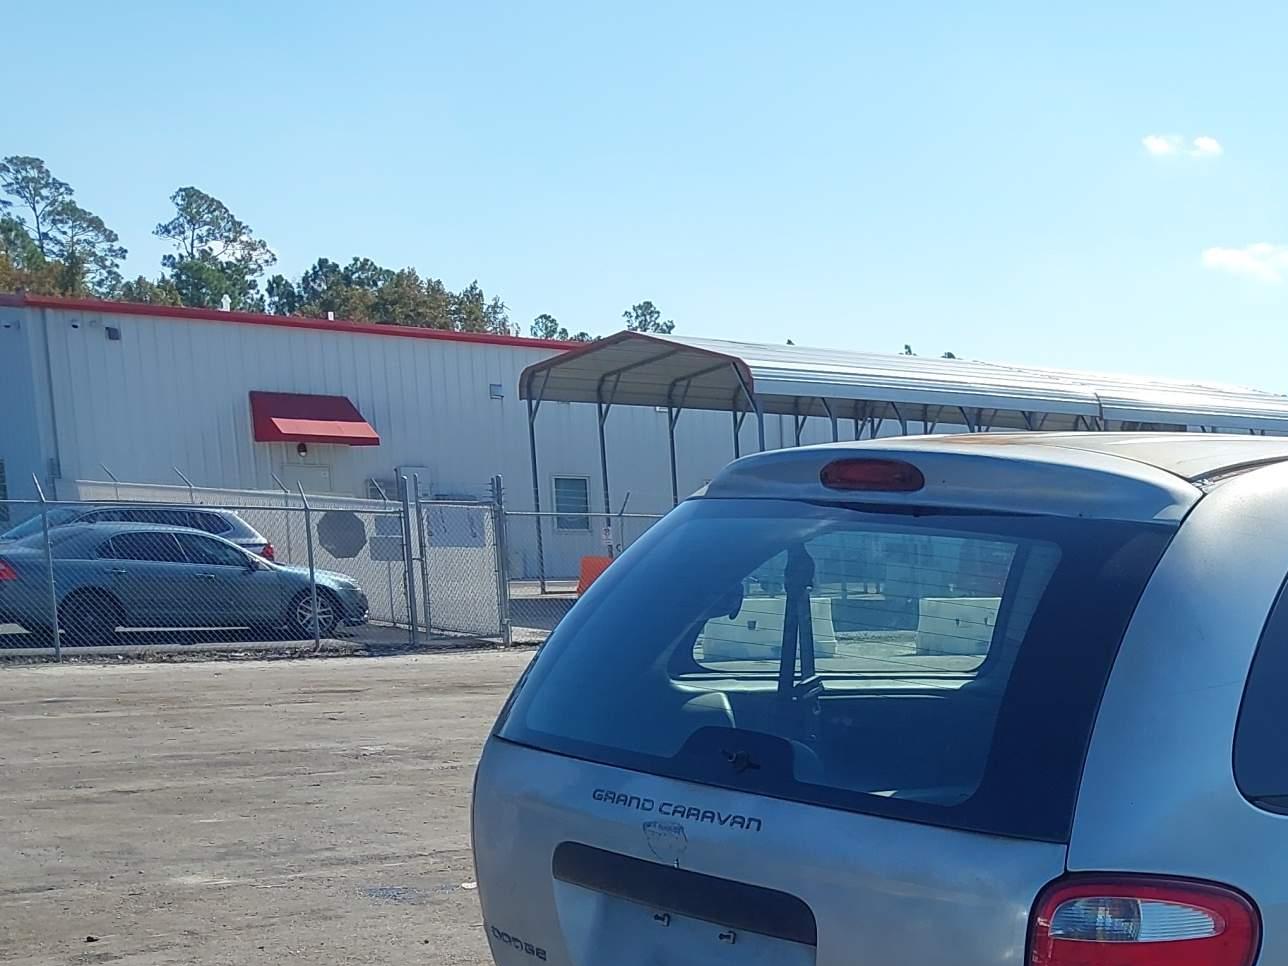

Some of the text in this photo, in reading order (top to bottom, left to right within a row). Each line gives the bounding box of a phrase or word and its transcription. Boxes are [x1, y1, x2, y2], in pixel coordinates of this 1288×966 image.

[592, 788, 655, 812] GRAND
[658, 802, 763, 832] CARAVAN
[491, 925, 547, 961] DODGE
